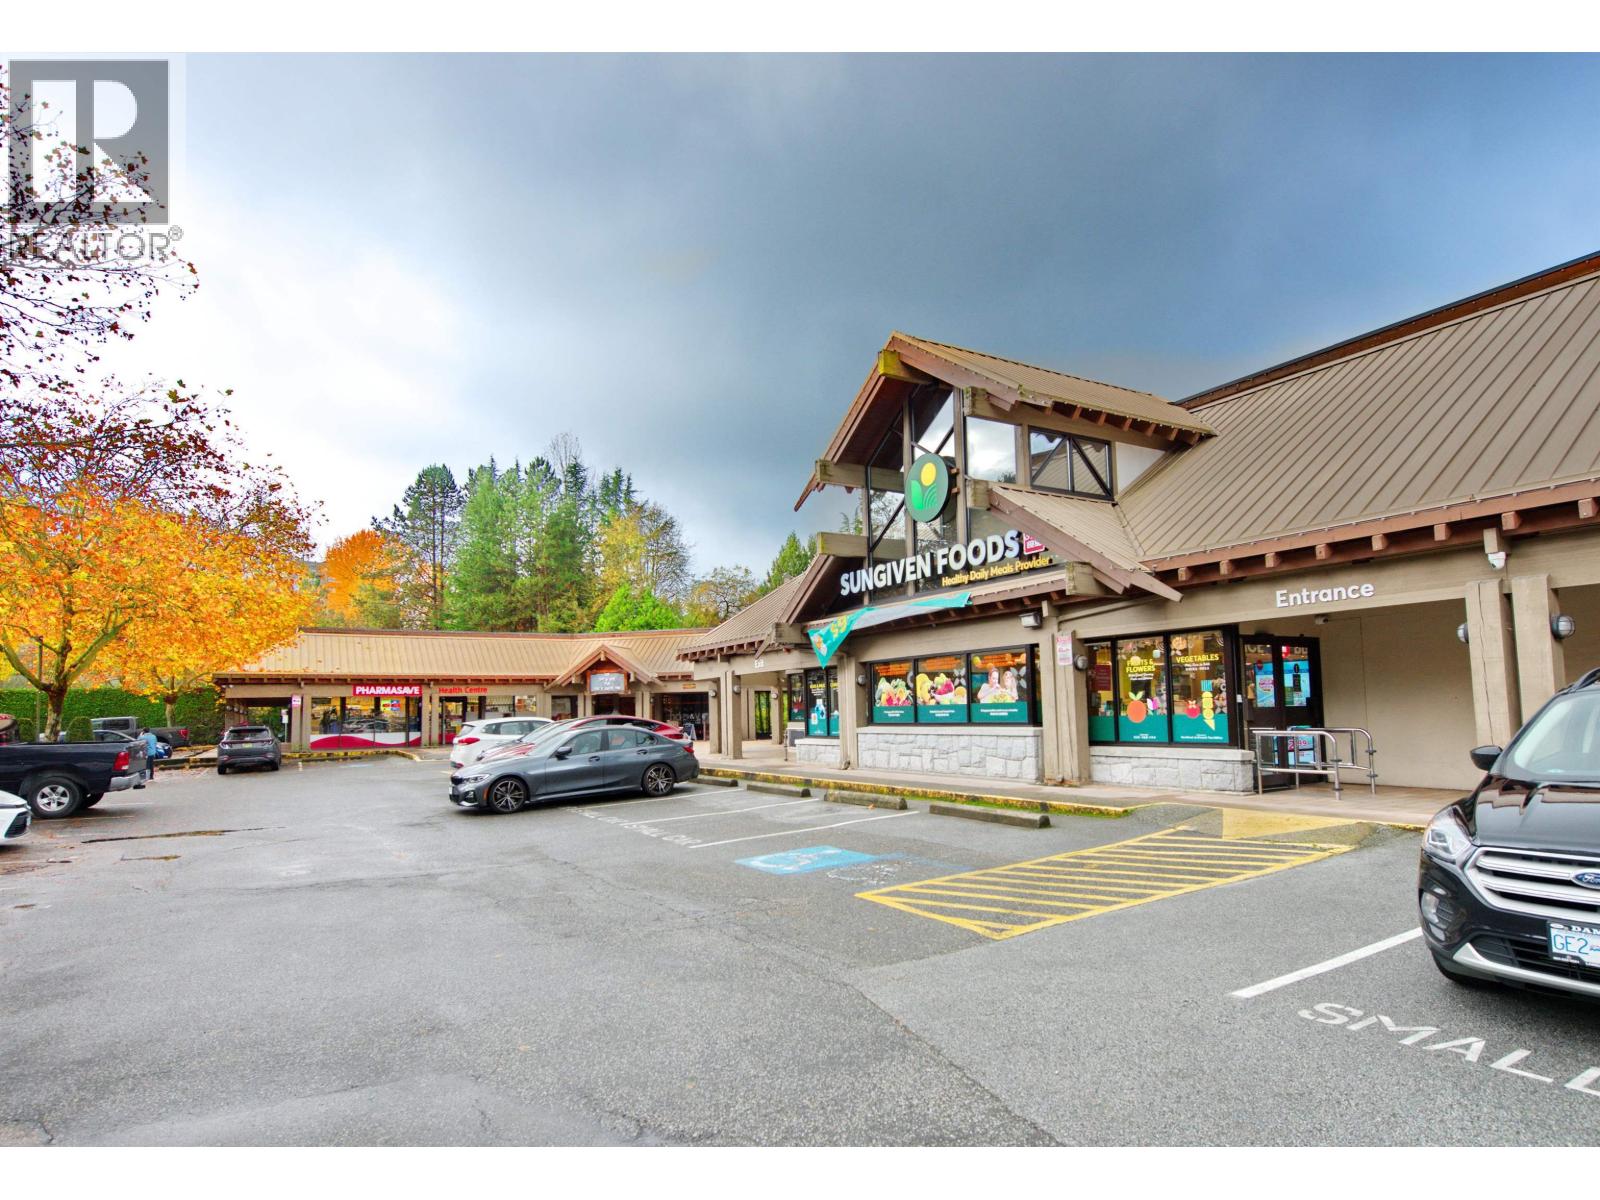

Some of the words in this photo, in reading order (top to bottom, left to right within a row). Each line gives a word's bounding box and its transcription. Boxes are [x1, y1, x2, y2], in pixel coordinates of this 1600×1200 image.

[840, 552, 932, 596] SUNGIVEN
[937, 529, 1021, 575] FOODS
[941, 571, 970, 588] Healthy
[970, 568, 990, 582] Daily
[990, 563, 1014, 577] Meals
[1015, 555, 1050, 571] Provider
[1275, 583, 1375, 608] Entrance
[1175, 653, 1220, 664] VEGETABLES
[1125, 665, 1156, 673] FLOWERS
[355, 686, 420, 695] PHARMASAVE
[438, 686, 463, 694] Health
[465, 686, 488, 694] Centre
